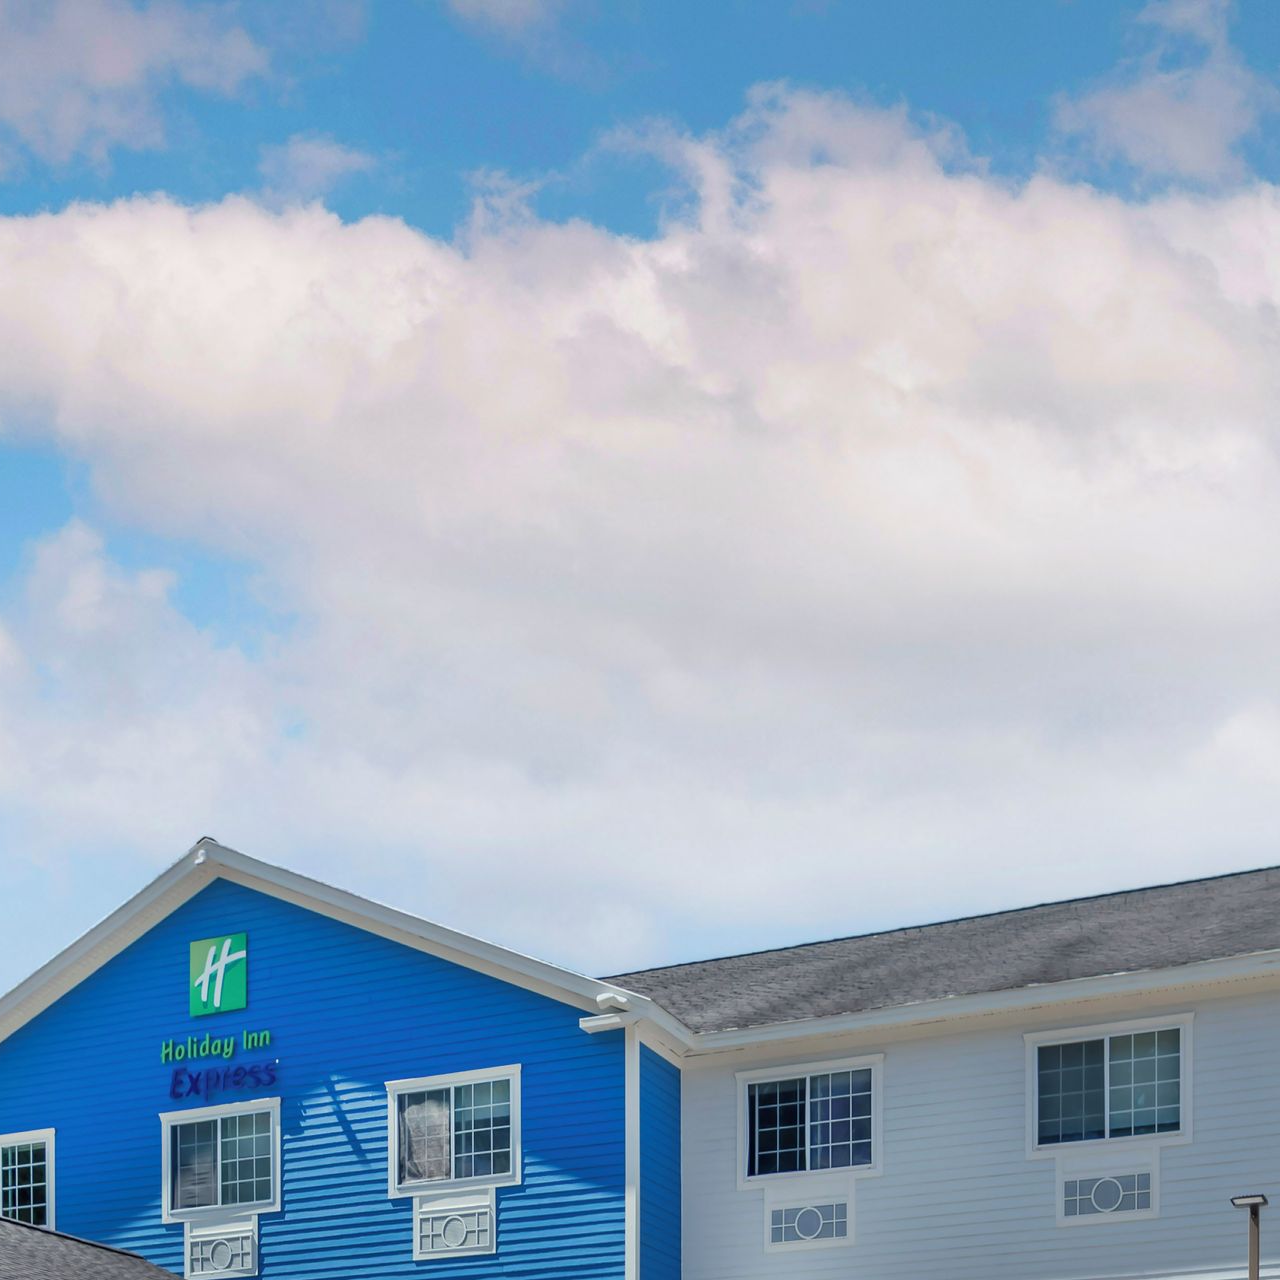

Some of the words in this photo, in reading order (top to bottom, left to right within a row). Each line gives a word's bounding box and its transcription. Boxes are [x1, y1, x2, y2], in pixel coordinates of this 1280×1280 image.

[161, 1032, 234, 1063] Holiday
[243, 1029, 271, 1049] Inn
[170, 1062, 277, 1101] Express
